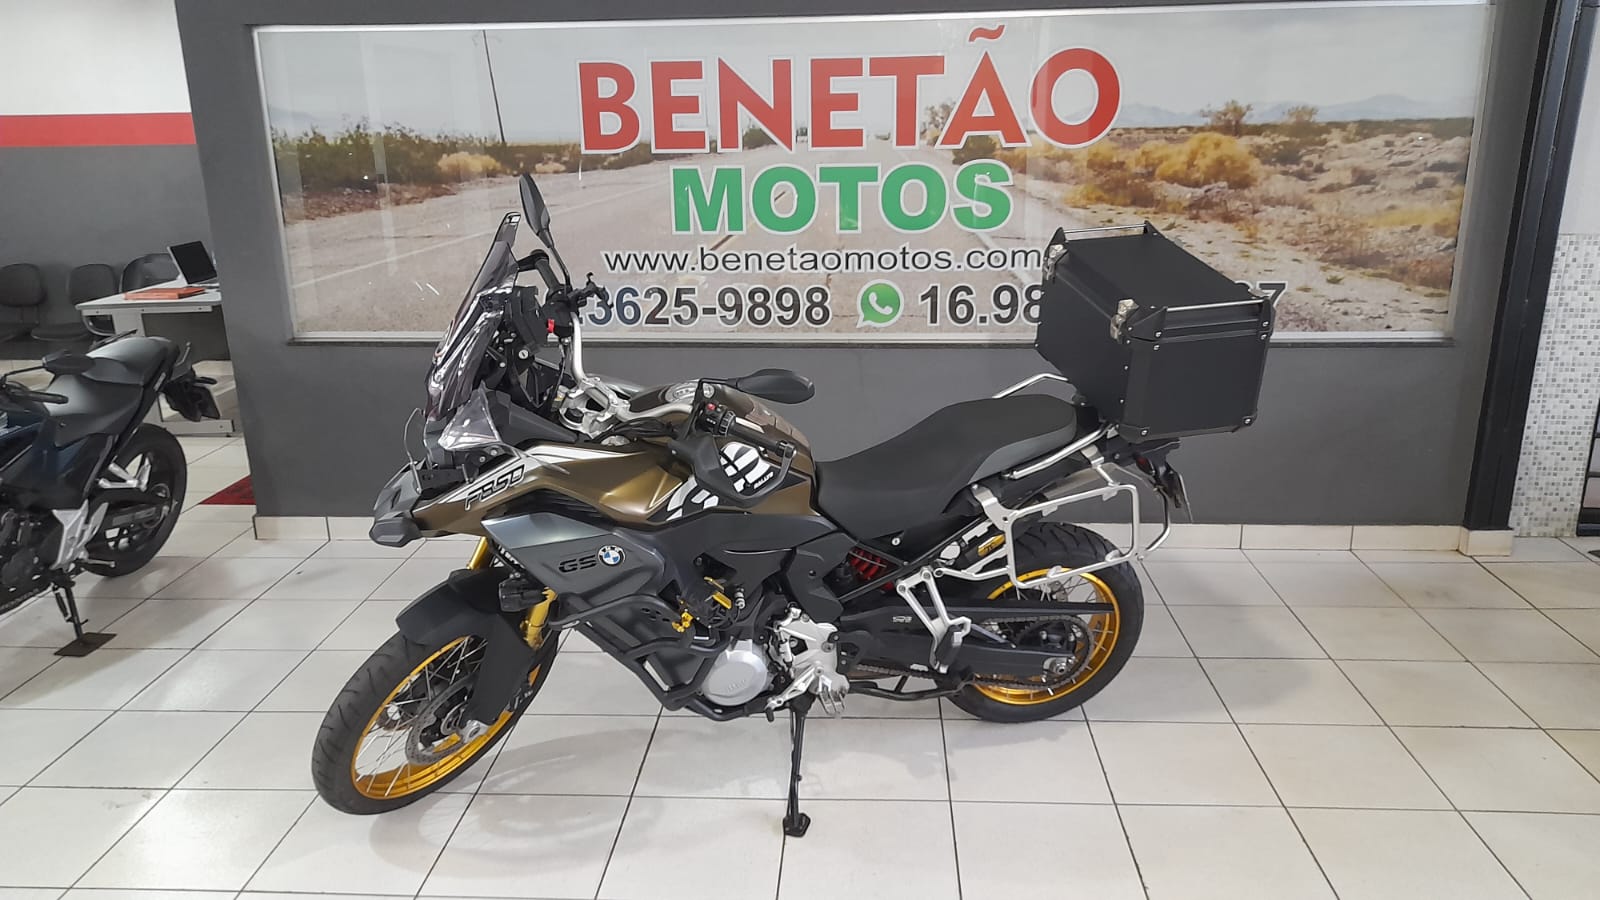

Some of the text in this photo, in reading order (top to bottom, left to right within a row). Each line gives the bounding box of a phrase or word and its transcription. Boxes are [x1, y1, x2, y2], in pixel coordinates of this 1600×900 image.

[578, 26, 1121, 153] BENETÃO
[672, 161, 1013, 234] MOTOS
[604, 247, 1041, 272] www.benetaomotos.com
[558, 554, 597, 573] GS
